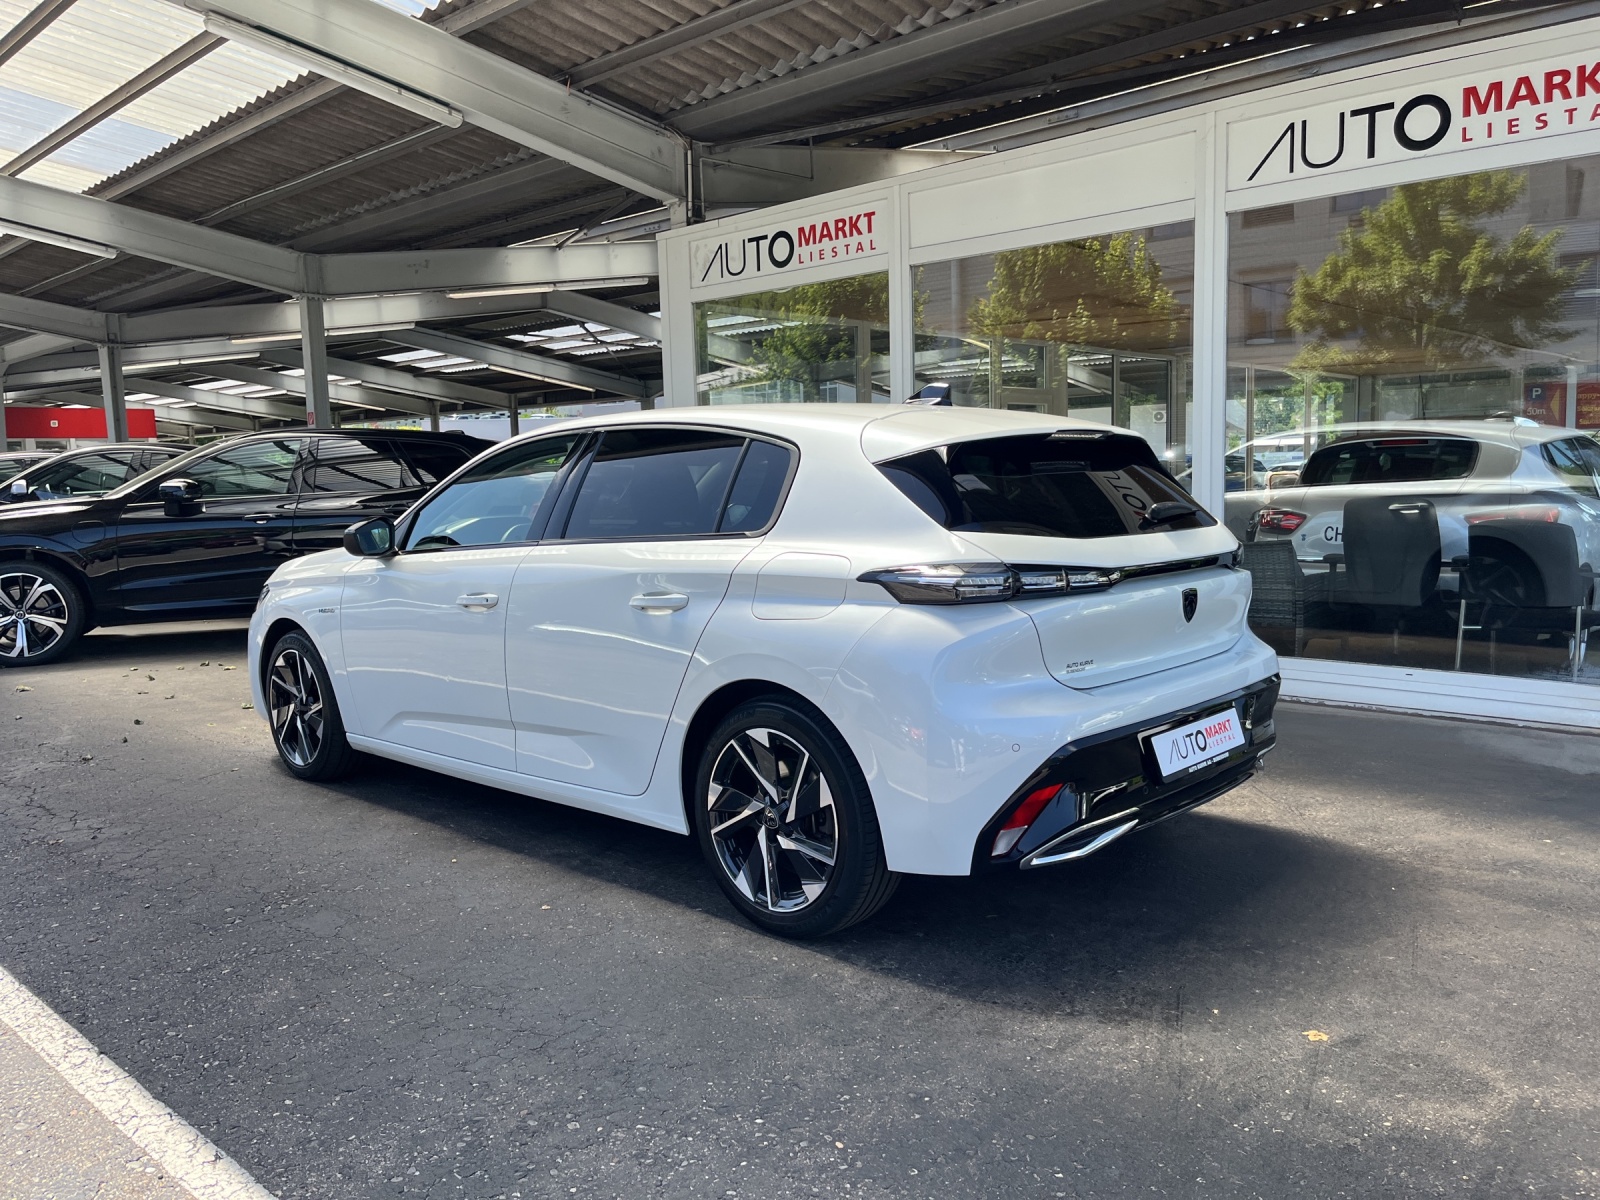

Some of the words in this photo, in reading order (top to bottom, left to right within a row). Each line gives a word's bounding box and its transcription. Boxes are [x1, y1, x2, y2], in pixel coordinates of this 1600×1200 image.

[1246, 94, 1452, 182] AUTO
[701, 230, 795, 282] AUTO
[797, 211, 876, 248] MARKT
[798, 239, 877, 265] LIESTAL
[1324, 525, 1344, 543] CH
[1169, 729, 1207, 765] AUTO
[1204, 718, 1232, 739] MARKT
[1208, 733, 1236, 749] LIESTAL
